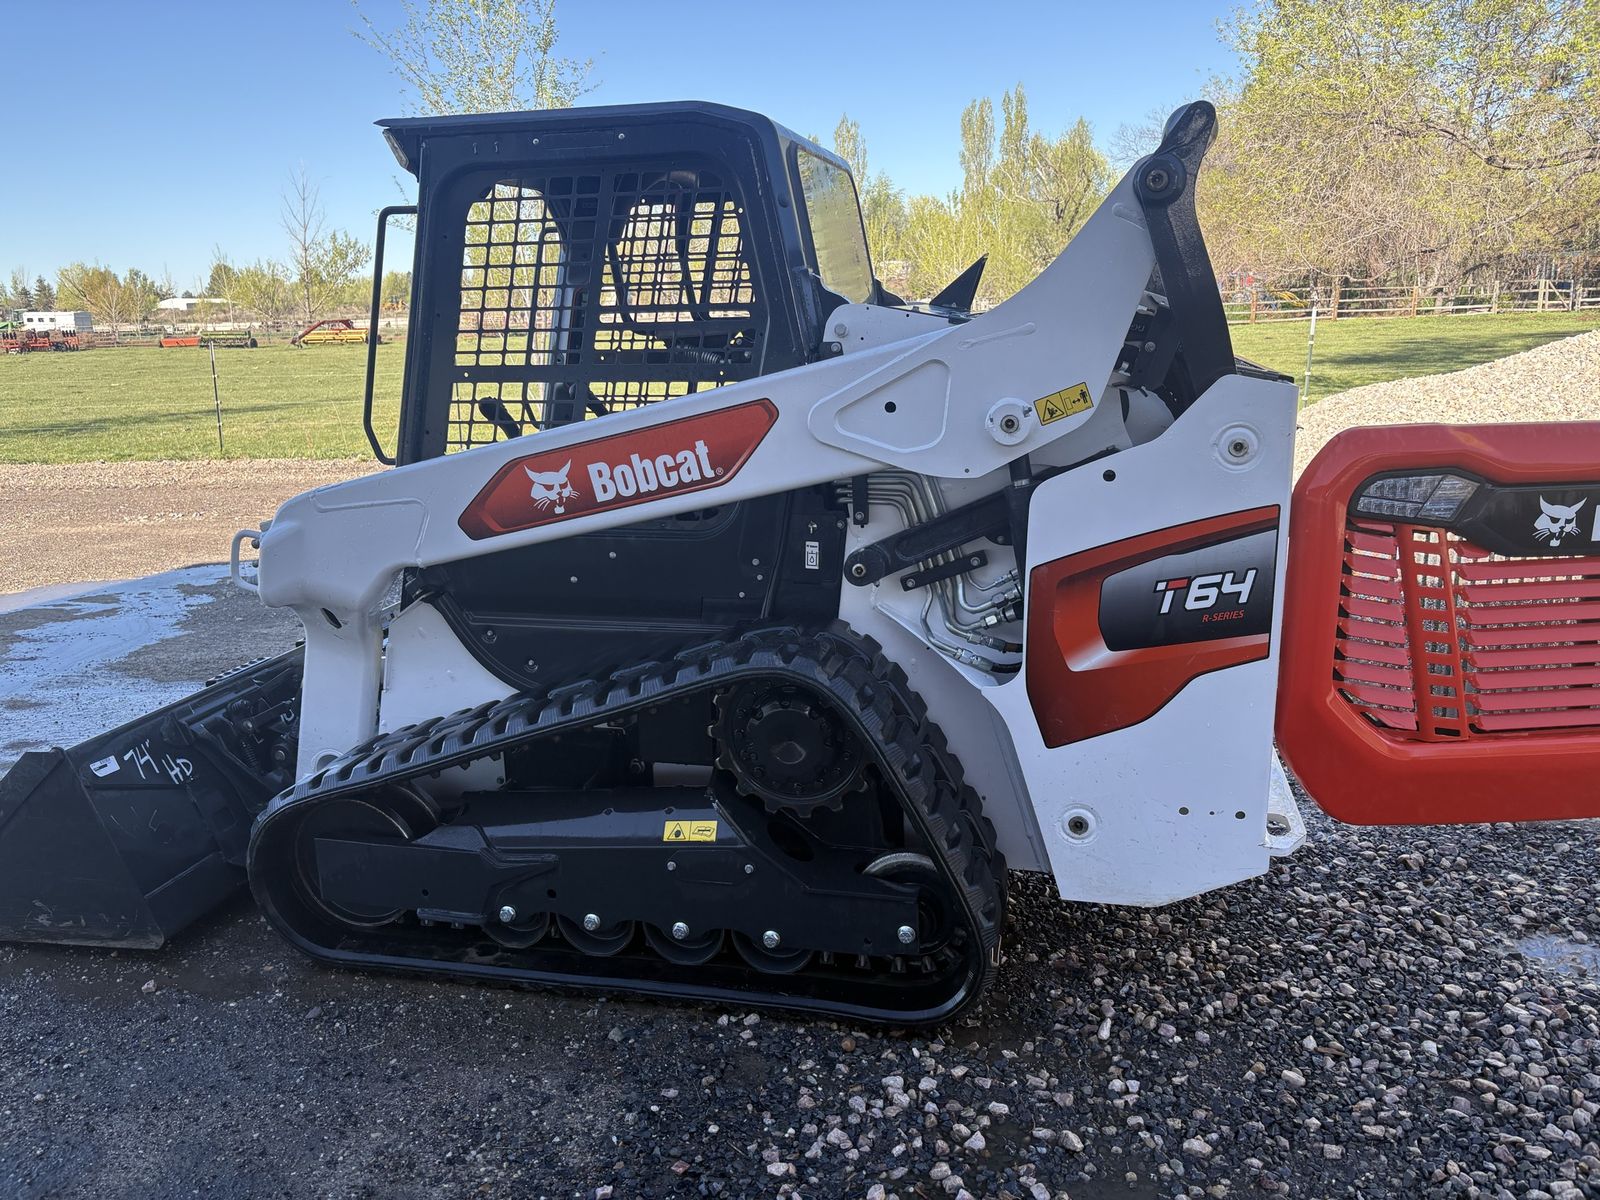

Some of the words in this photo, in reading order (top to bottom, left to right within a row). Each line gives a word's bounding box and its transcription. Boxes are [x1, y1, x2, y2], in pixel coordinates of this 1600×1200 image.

[587, 439, 715, 503] Bobcat
[1155, 569, 1257, 614] T64
[1202, 609, 1245, 623] R-SERIES
[161, 753, 193, 785] HD
